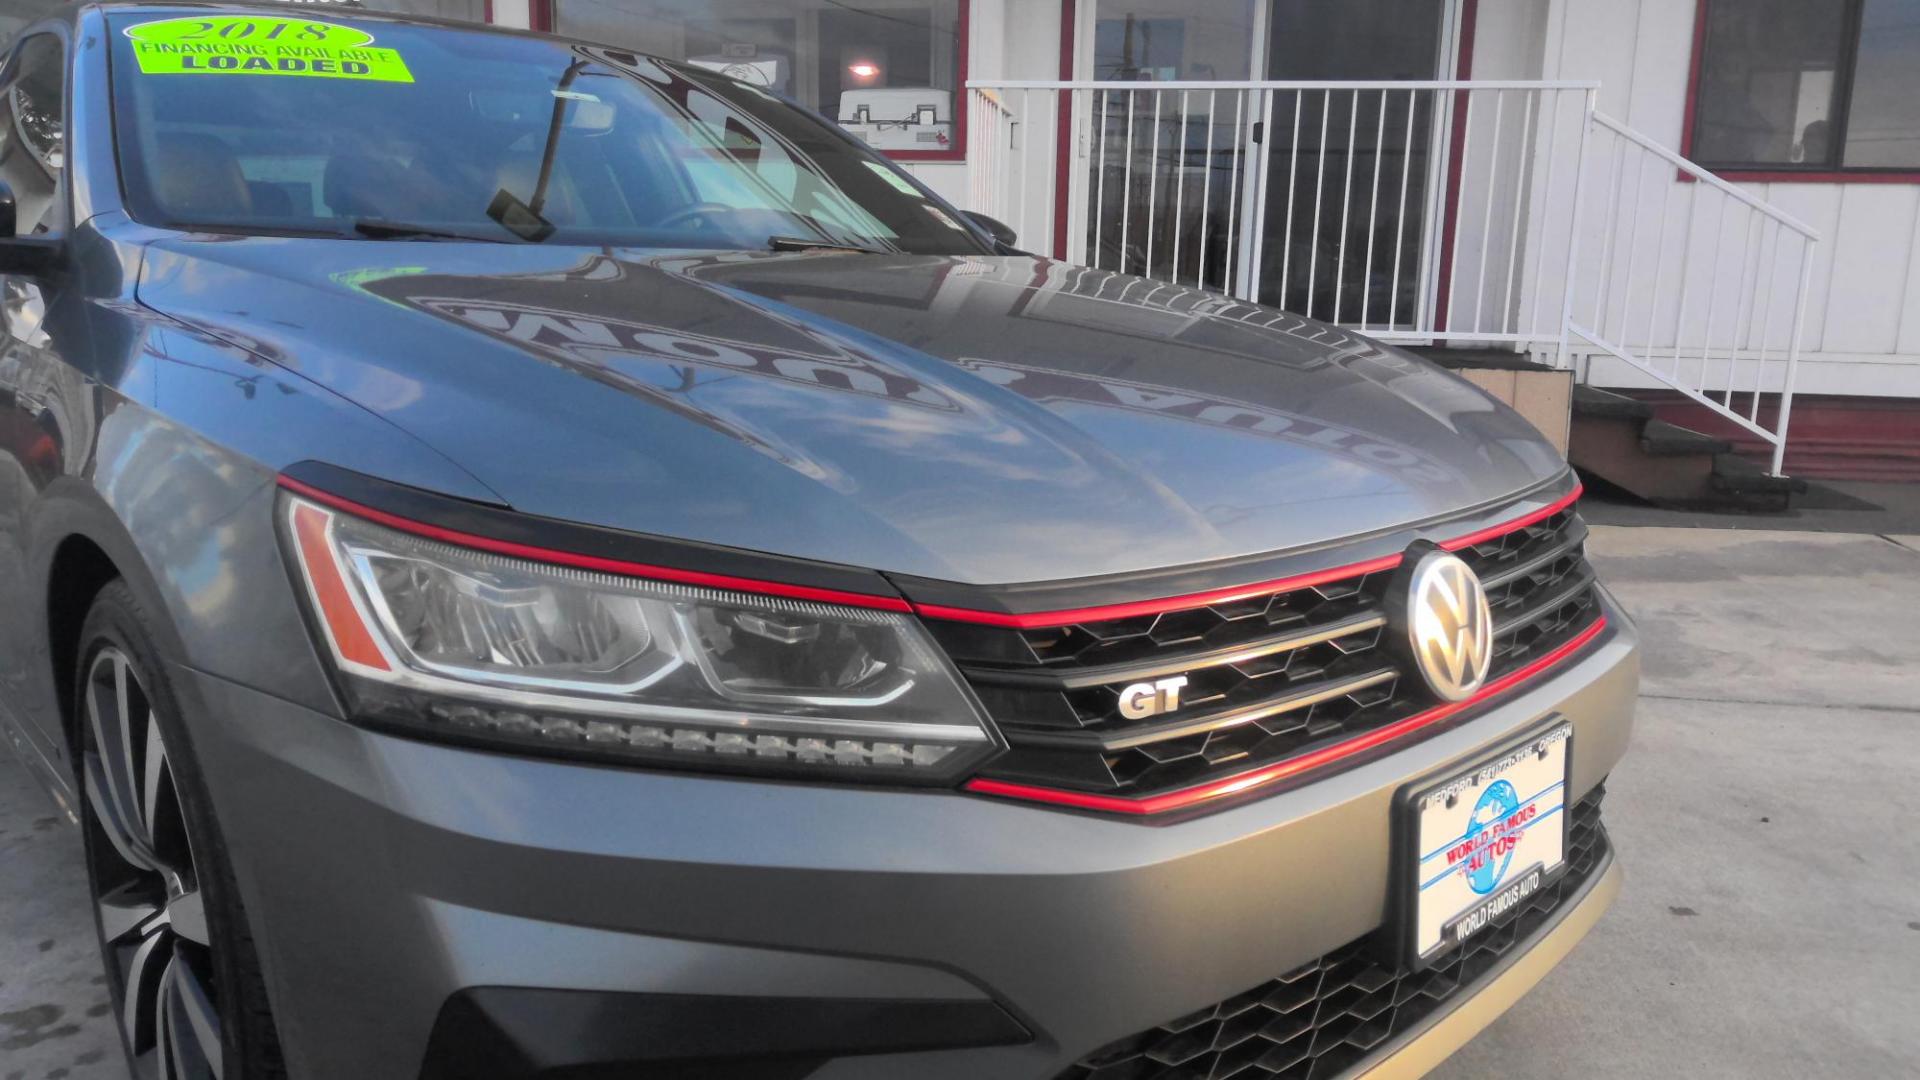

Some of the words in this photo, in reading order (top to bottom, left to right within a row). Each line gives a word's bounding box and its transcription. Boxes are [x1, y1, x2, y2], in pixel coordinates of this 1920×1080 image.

[180, 21, 332, 42] 2018
[141, 41, 267, 56] FINANCING
[276, 45, 393, 63] AVAILABLE
[181, 55, 372, 75] LOADED
[1118, 676, 1188, 720] GT
[1426, 778, 1472, 806] MEDFORD
[1446, 830, 1489, 865] WORLD
[1493, 803, 1536, 838] FAMOUS
[1468, 836, 1516, 872] AUTOS
[1456, 907, 1488, 941] WORLD
[1487, 886, 1519, 921] FAMOUS
[1519, 871, 1540, 900] AUTO
